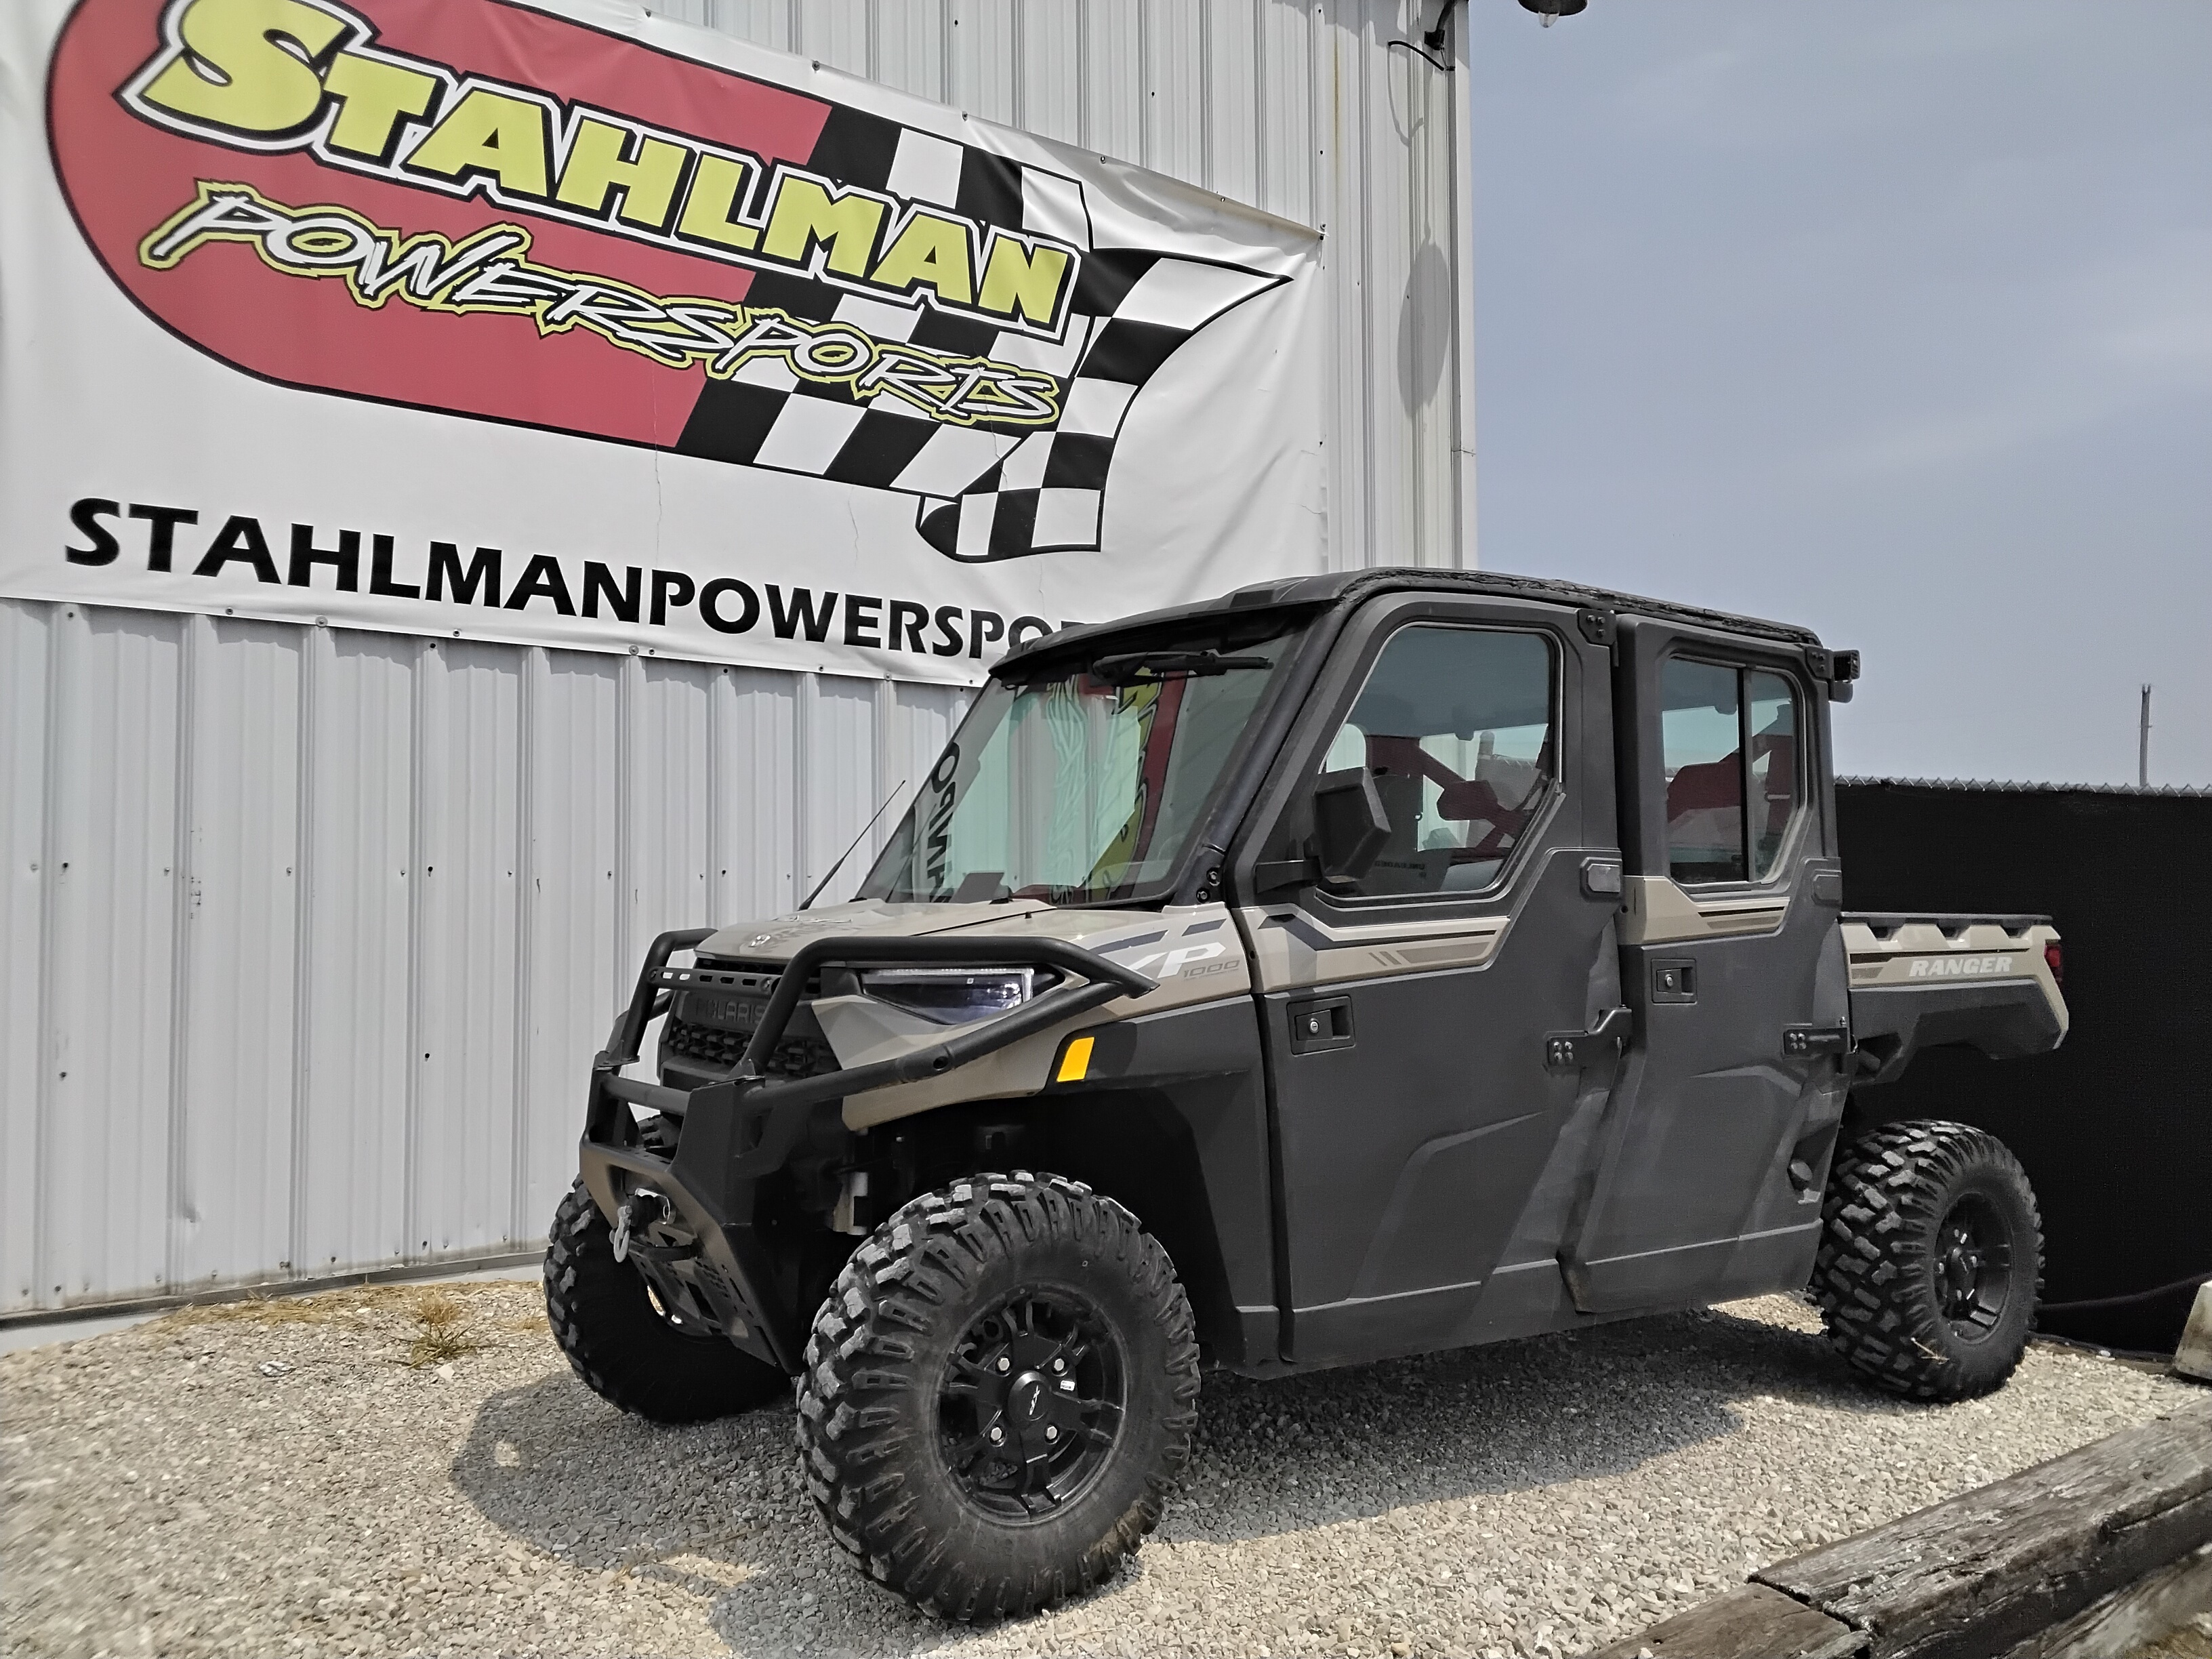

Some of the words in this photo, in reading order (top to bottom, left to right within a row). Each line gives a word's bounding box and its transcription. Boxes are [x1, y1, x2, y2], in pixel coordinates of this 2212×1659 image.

[129, 0, 1074, 333] STAHLMAN
[148, 188, 1055, 418] POWERSPORTS
[64, 497, 1084, 659] STAHLMANPOWERSPO
[1183, 960, 1240, 978] 1000
[1908, 956, 2013, 977] RANGER
